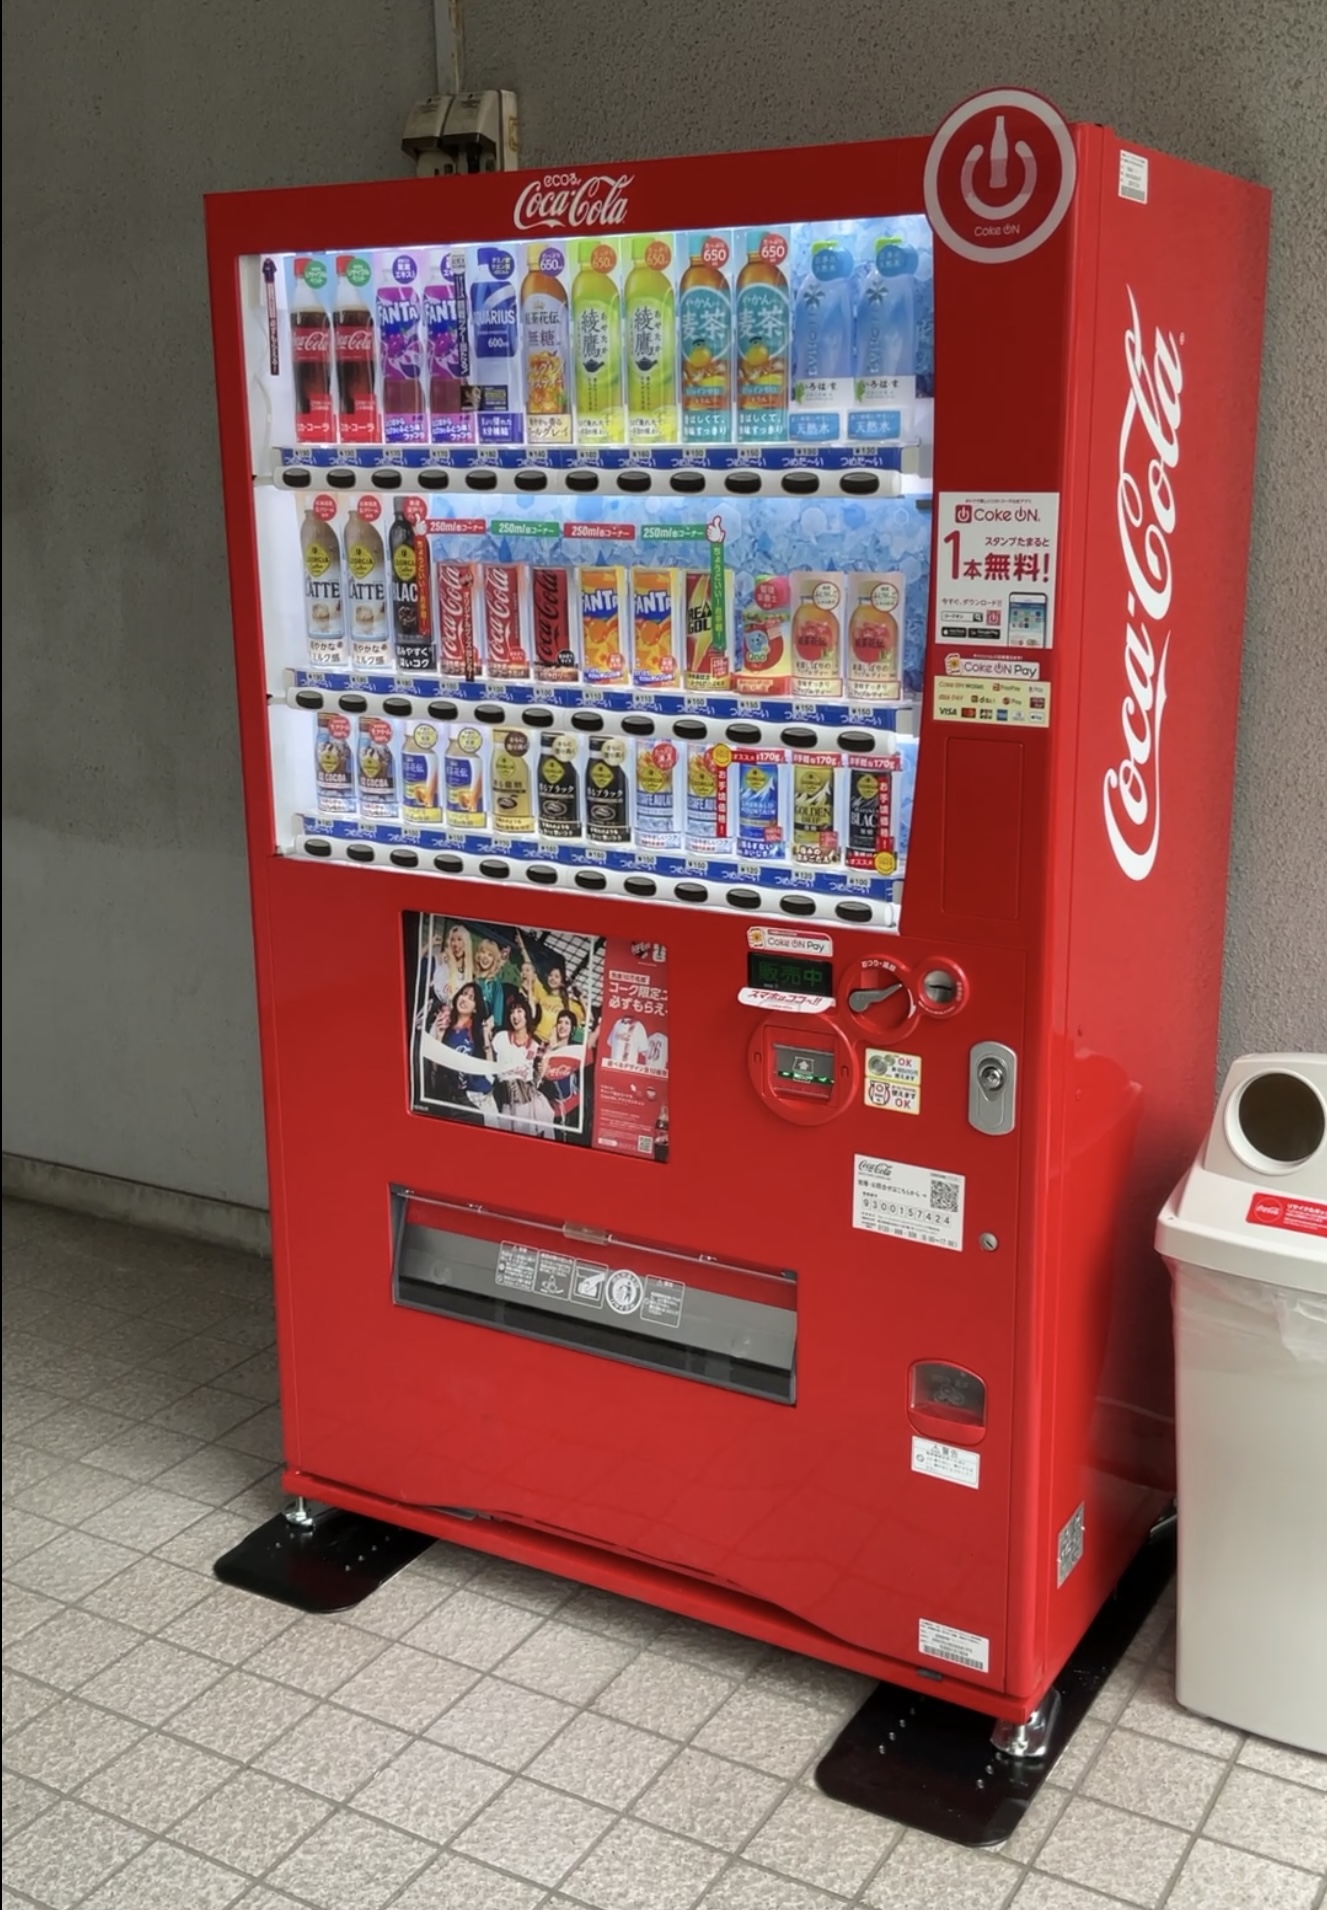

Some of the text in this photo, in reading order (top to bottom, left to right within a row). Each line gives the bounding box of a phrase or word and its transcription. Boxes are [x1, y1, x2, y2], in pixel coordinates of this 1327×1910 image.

[514, 174, 636, 231] Coca-Cola
[974, 224, 1020, 237] Coke ON
[704, 249, 727, 262] 650
[762, 245, 785, 258] 650
[424, 300, 457, 325] FANT
[682, 308, 728, 340] 麦茶
[740, 305, 785, 338] 麦茶
[581, 308, 600, 358] 綾鷹
[634, 306, 654, 356] 綾鷹
[974, 506, 1038, 521] Coke ON
[985, 536, 1050, 547] スタンプたまると
[305, 582, 341, 598] ATTE
[1103, 284, 1183, 881] Coca-Cola
[688, 600, 713, 620] REA
[688, 618, 712, 635] GOL
[964, 661, 1037, 678] Coke ON Pay
[851, 812, 878, 828] BLAC
[767, 937, 825, 952] Coke ON Pay
[759, 961, 823, 987] 販売中
[609, 995, 668, 1017] 必ずもらえ
[897, 1057, 912, 1067] OK
[895, 1098, 911, 1109] OK
[858, 1159, 893, 1176] Coca-Cola
